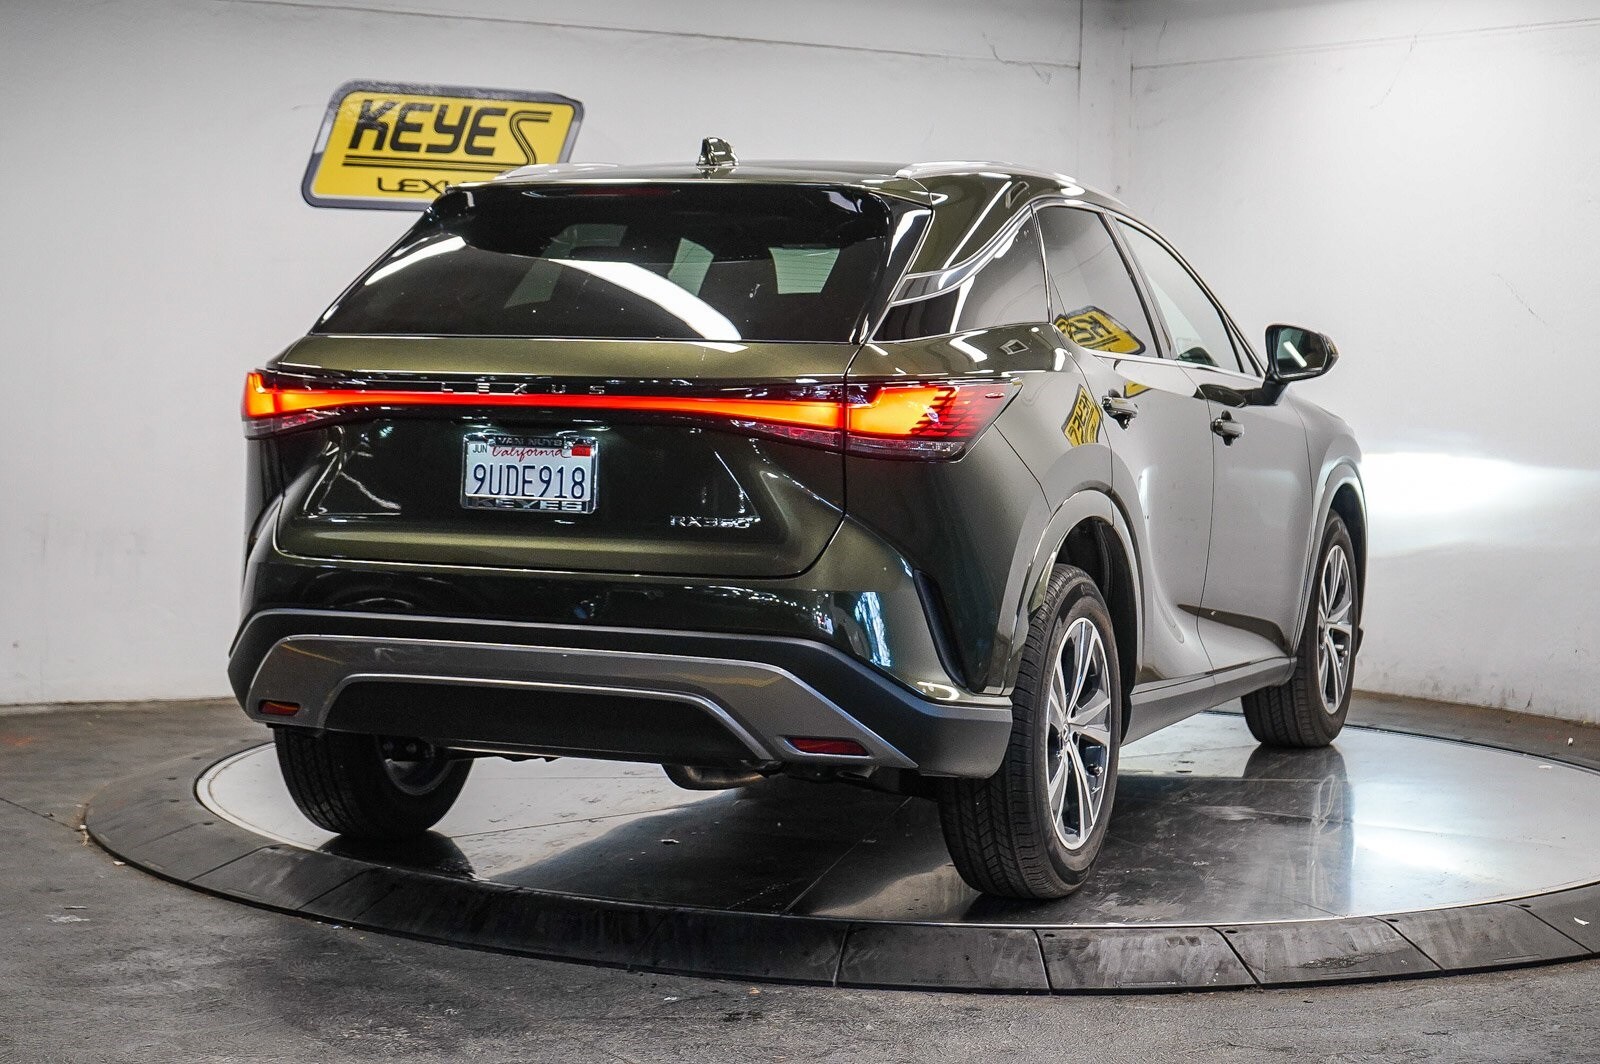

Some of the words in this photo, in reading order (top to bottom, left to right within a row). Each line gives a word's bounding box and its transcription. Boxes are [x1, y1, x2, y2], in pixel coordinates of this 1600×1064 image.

[348, 99, 551, 163] KEYES
[377, 176, 466, 195] LEX
[441, 382, 605, 394] LEXUS
[472, 443, 488, 453] JUN
[498, 437, 525, 445] VAN
[528, 438, 563, 447] NUYS
[491, 445, 572, 462] California
[473, 463, 586, 499] 9UDE918
[477, 498, 583, 511] KEYES
